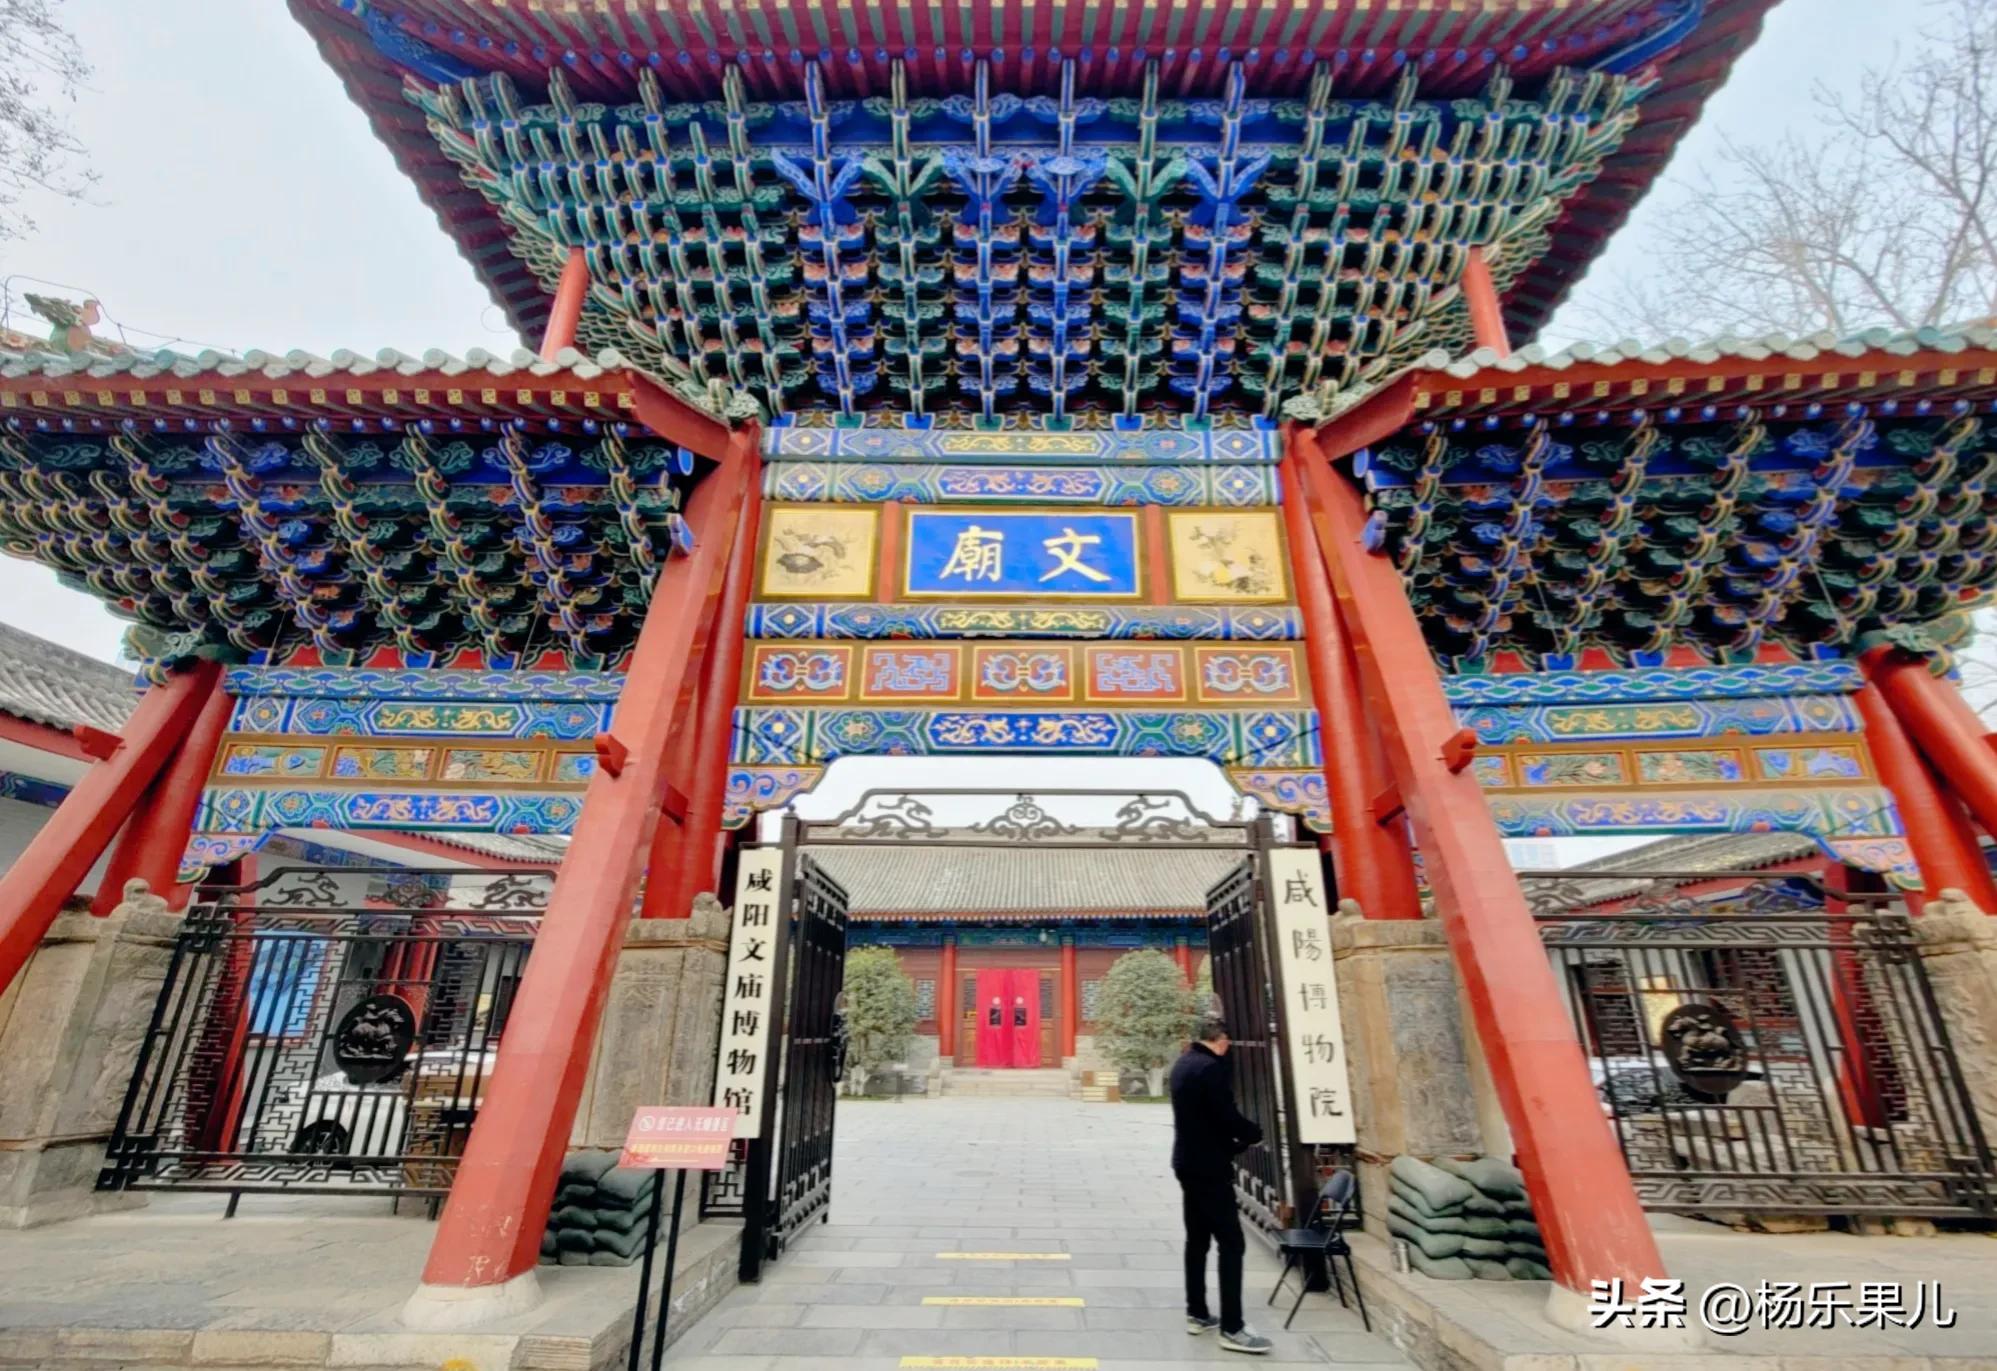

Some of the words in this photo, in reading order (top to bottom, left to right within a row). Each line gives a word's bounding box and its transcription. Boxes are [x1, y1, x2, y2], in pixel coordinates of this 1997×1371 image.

[723, 868, 774, 1115] 咸阳文庙博物馆
[1284, 869, 1343, 1117] 咸陽博物院
